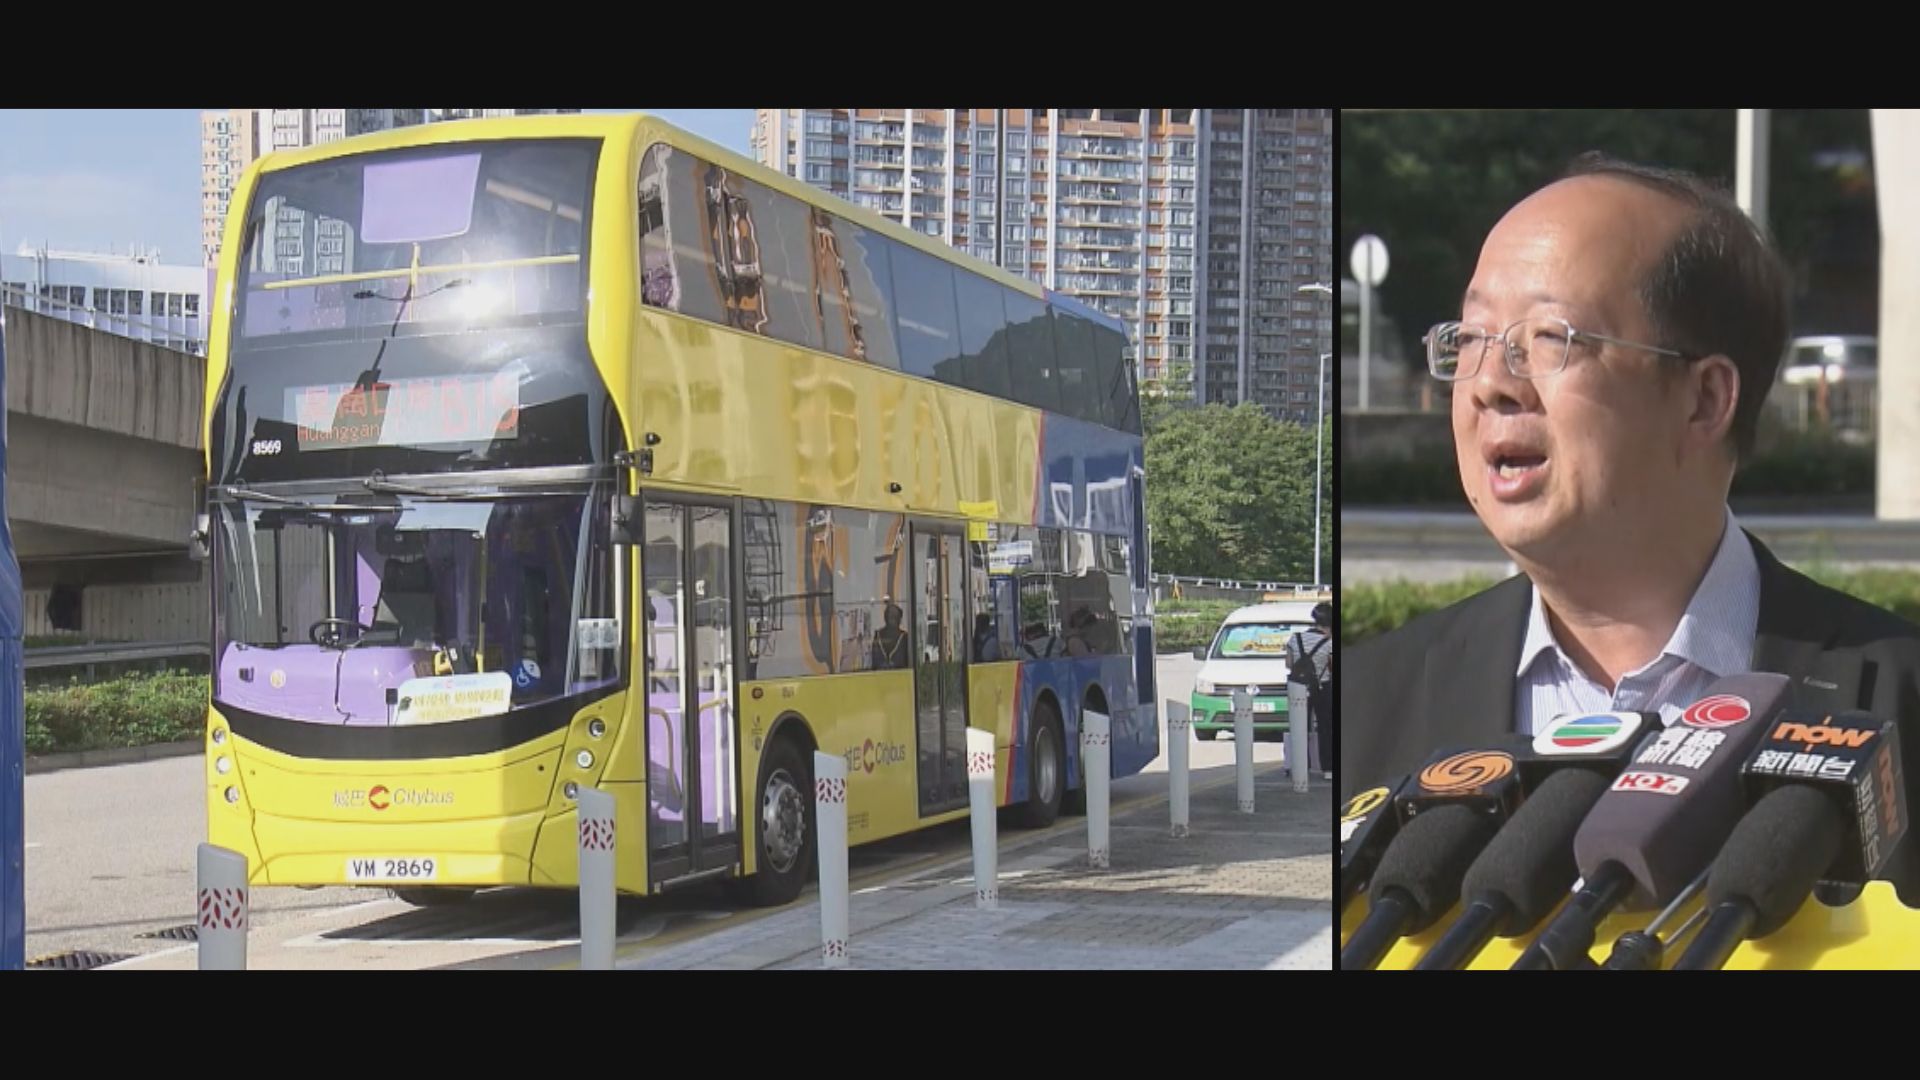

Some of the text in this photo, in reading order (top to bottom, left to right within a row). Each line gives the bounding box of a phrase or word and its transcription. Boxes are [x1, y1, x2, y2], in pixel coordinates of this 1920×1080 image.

[297, 422, 386, 443] Huanggan
[253, 440, 281, 455] 8569
[1772, 721, 1877, 748] now
[1752, 749, 1857, 777] 新聞台
[1618, 773, 1675, 789] HOY
[334, 789, 366, 807] 城巴
[393, 788, 455, 806] Citybus
[353, 859, 434, 877] VM 2869
